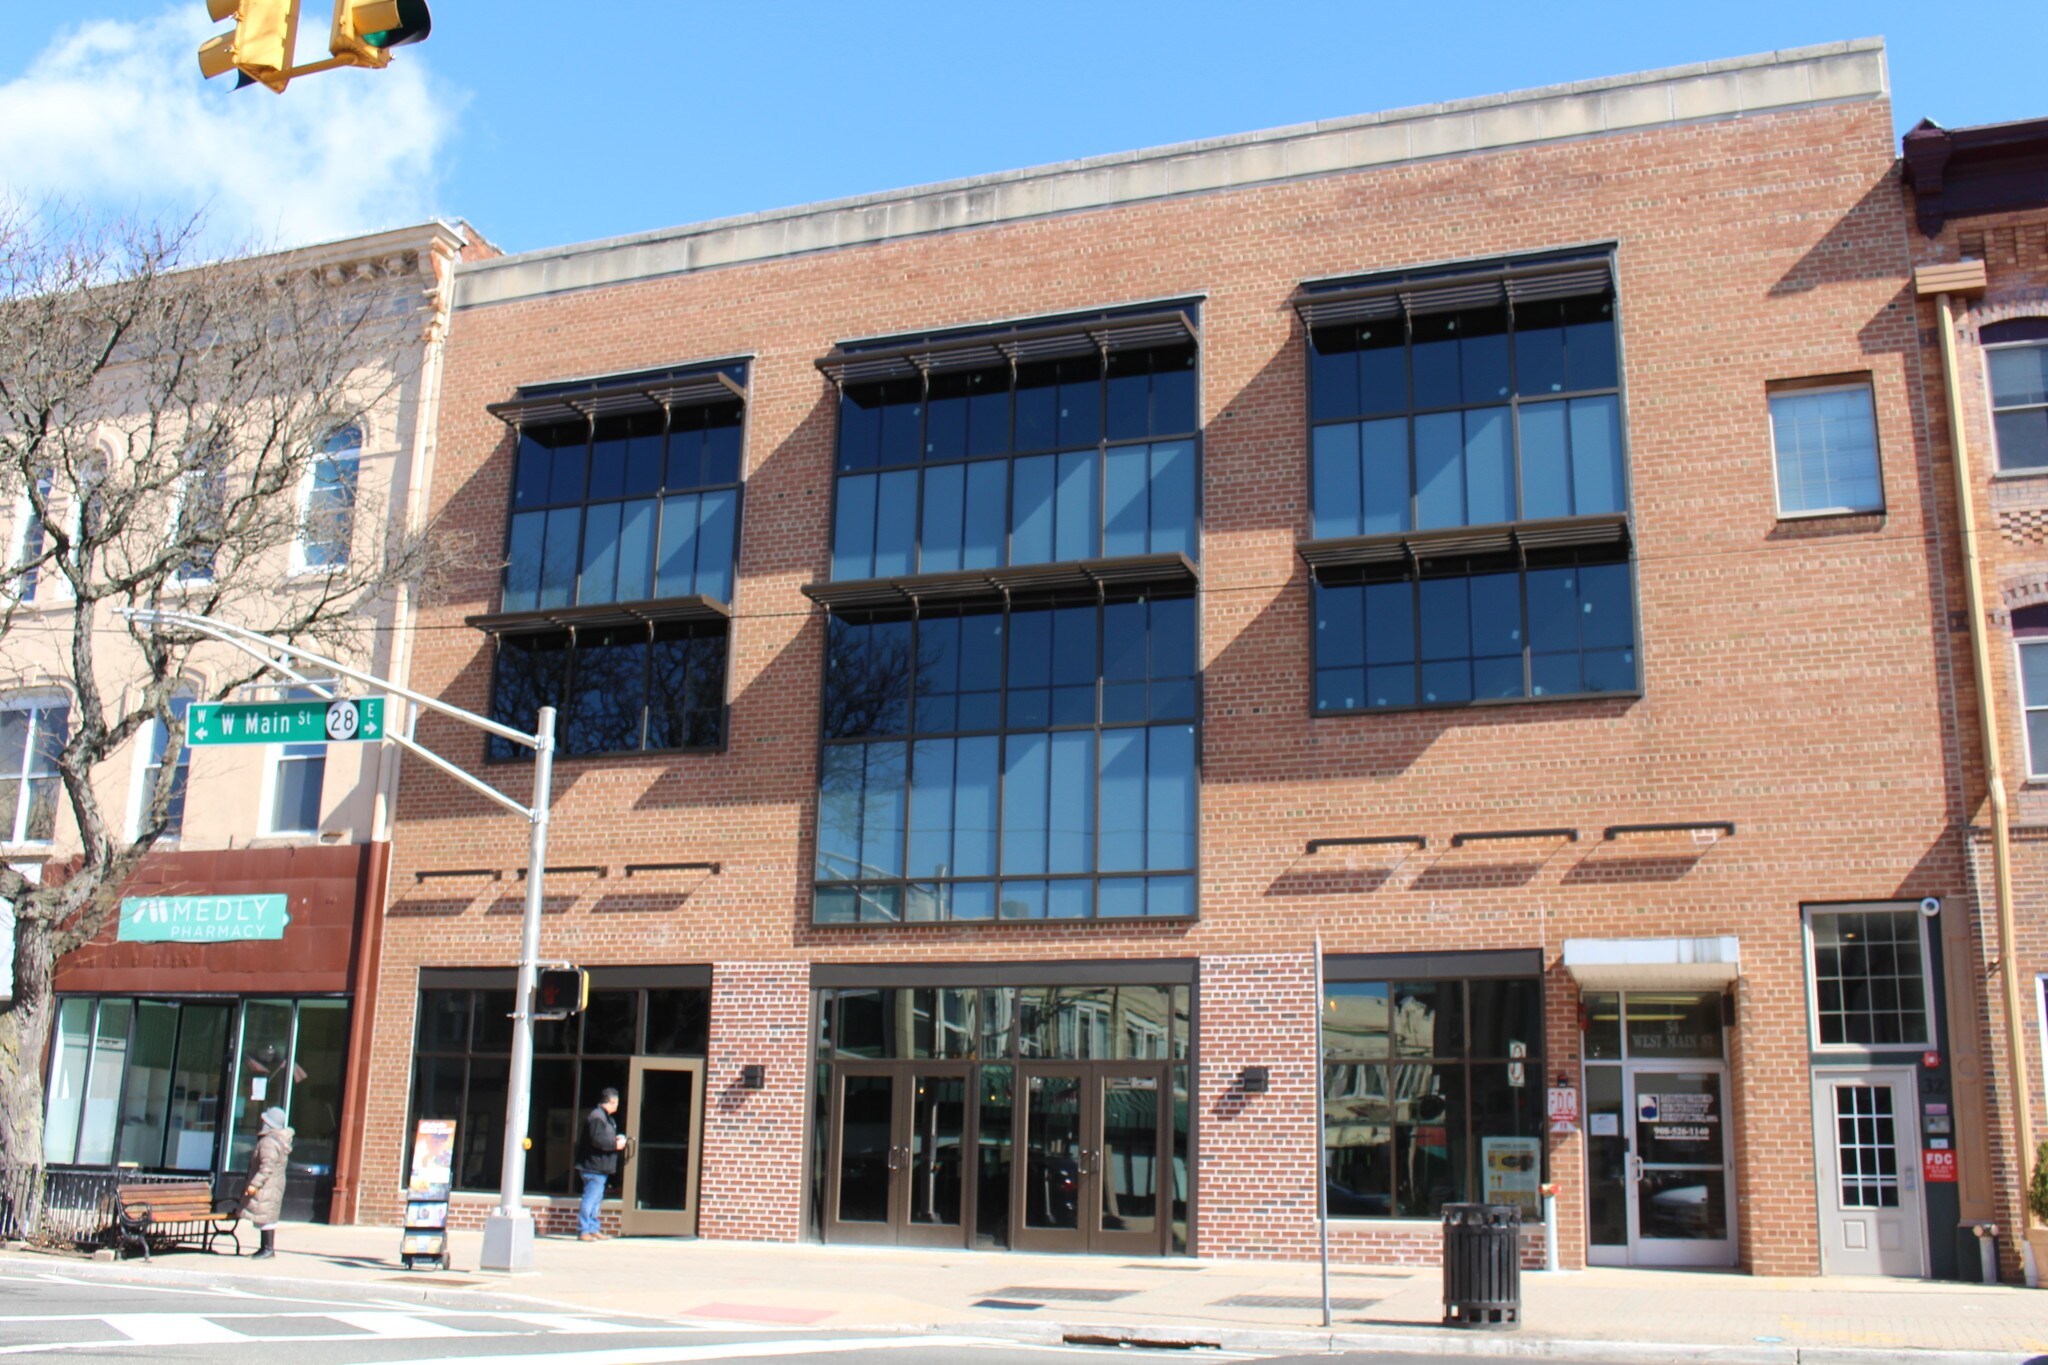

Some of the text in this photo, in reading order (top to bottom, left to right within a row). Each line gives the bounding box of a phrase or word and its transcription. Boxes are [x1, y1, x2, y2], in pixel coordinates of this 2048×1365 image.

[197, 709, 207, 723] W
[367, 703, 375, 718] E
[221, 710, 311, 735] W Main St
[330, 709, 354, 731] 28
[173, 898, 269, 922] MEDLY
[171, 924, 266, 938] PHARMACY
[1631, 1034, 1662, 1048] WEST
[1666, 1034, 1698, 1049] MAIN
[1921, 1077, 1945, 1095] 32
[1926, 1152, 1953, 1165] FDC
